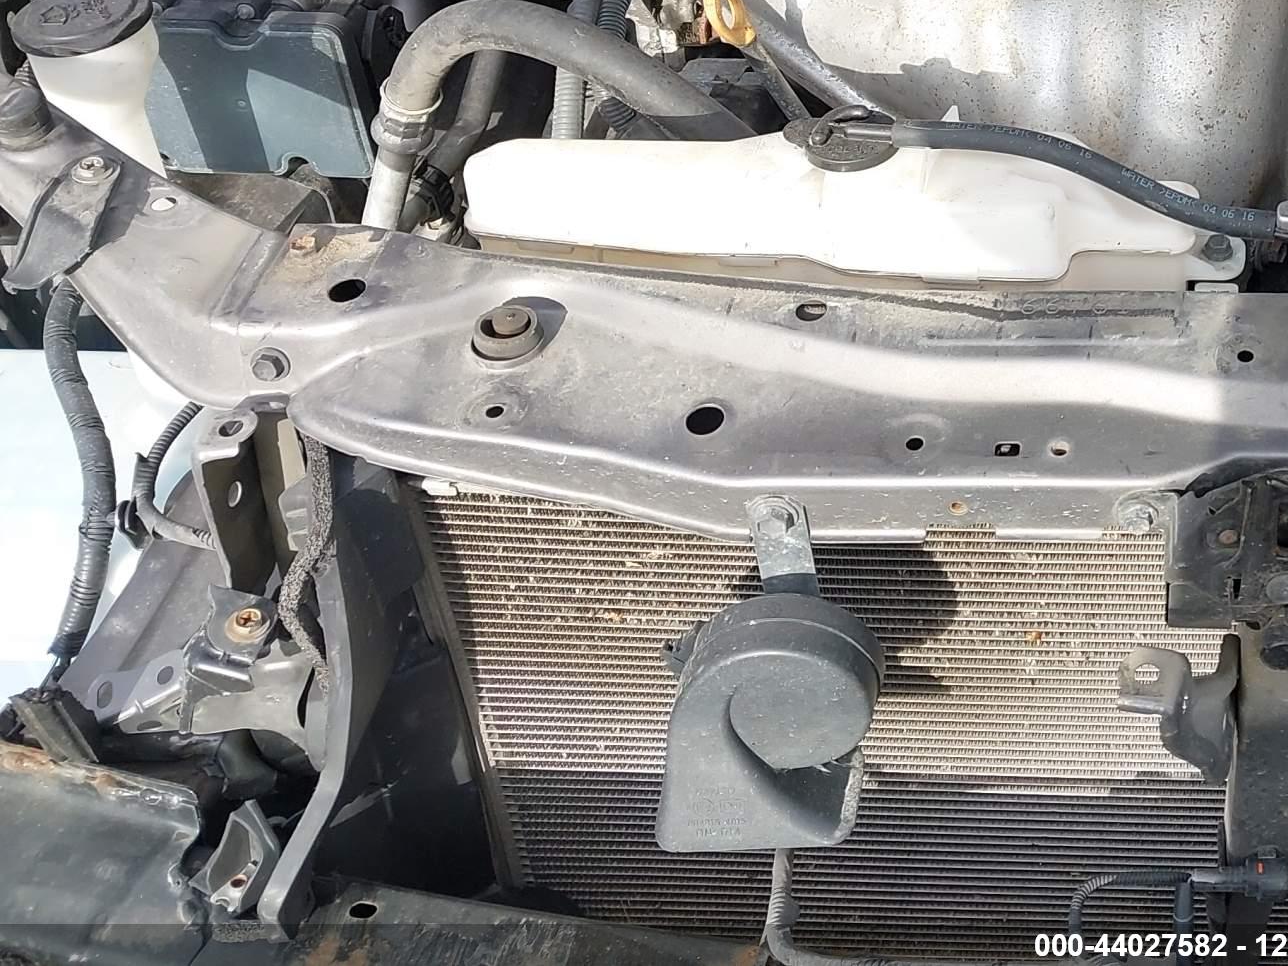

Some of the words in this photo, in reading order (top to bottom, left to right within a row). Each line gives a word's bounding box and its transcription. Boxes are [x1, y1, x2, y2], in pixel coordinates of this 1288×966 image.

[1036, 133, 1053, 144] 04
[1078, 148, 1093, 160] 16
[1120, 167, 1156, 192] WATER
[1202, 203, 1218, 215] 04
[1221, 208, 1236, 220] 06
[1241, 211, 1256, 222] 16
